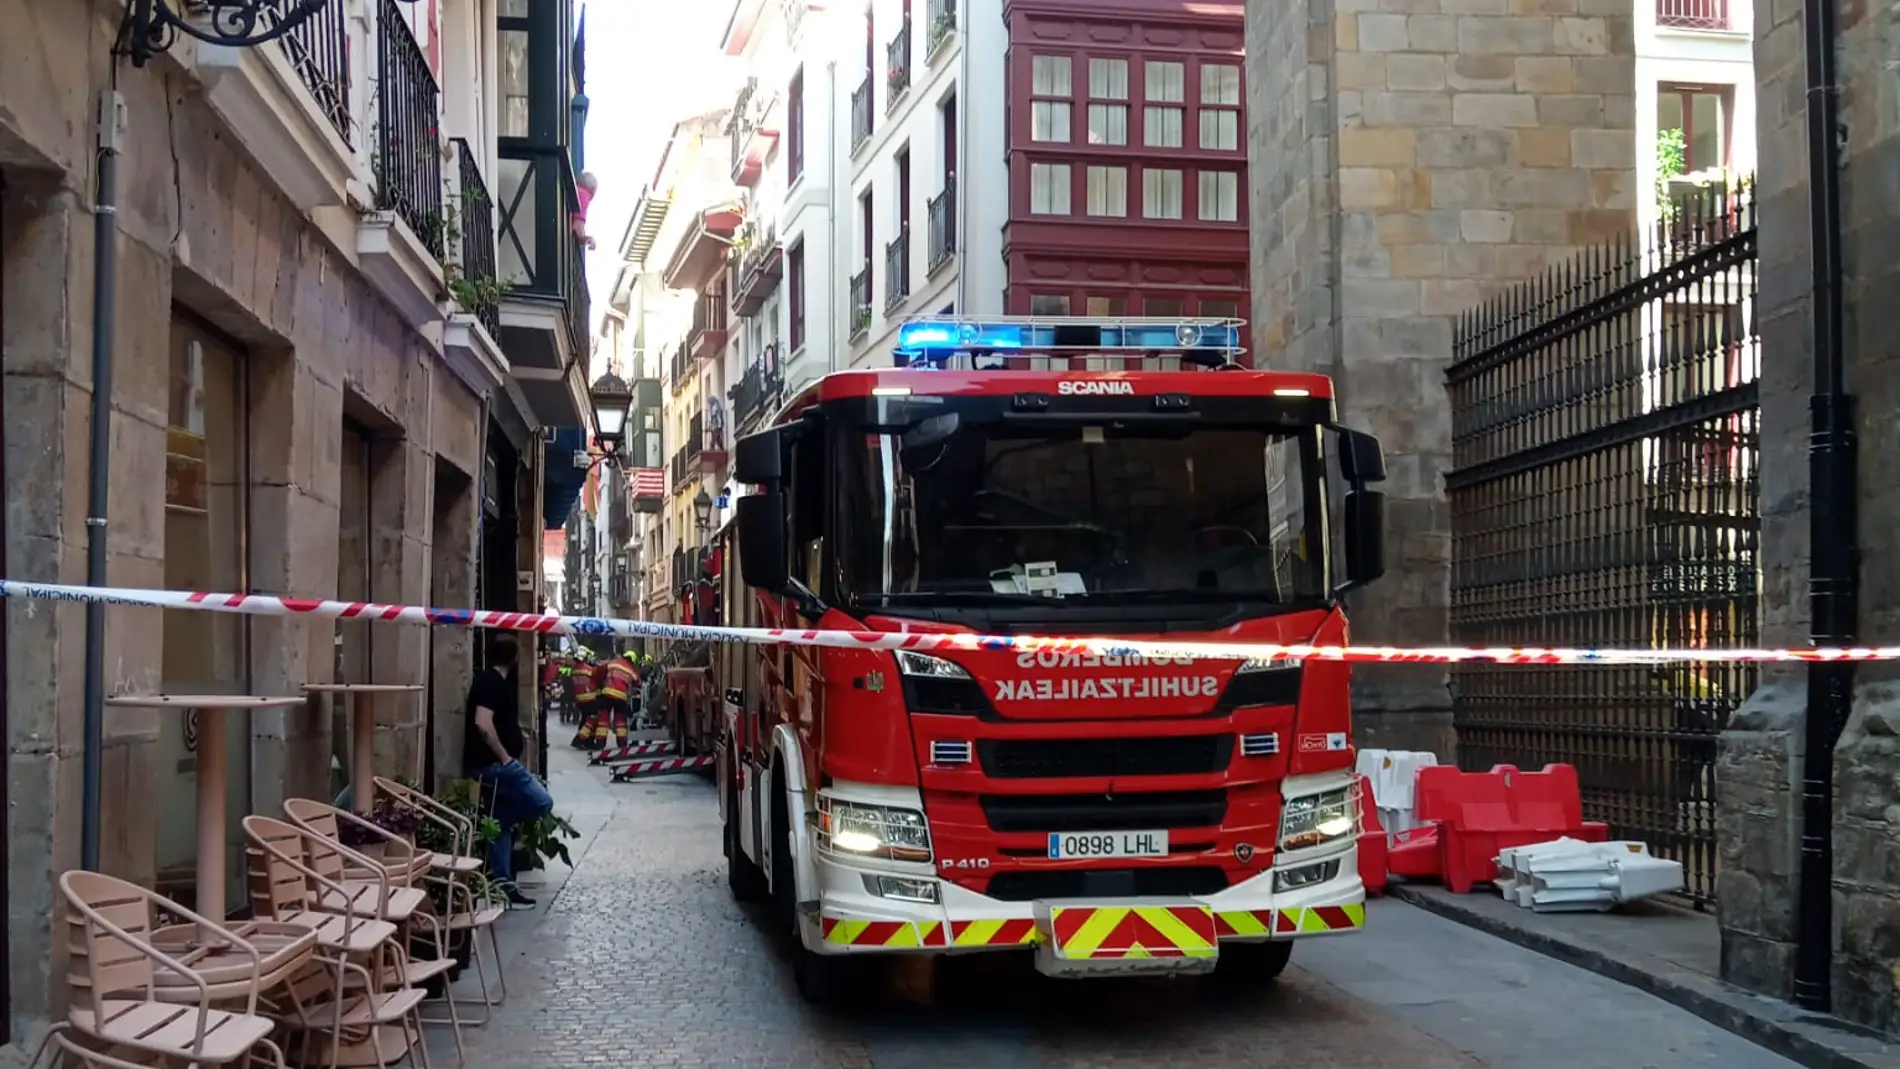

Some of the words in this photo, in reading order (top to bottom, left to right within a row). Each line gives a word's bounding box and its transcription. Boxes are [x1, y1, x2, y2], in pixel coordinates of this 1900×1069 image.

[1058, 381, 1135, 395] SCANIA
[1065, 835, 1115, 855] 0898
[1124, 833, 1161, 854] LHL
